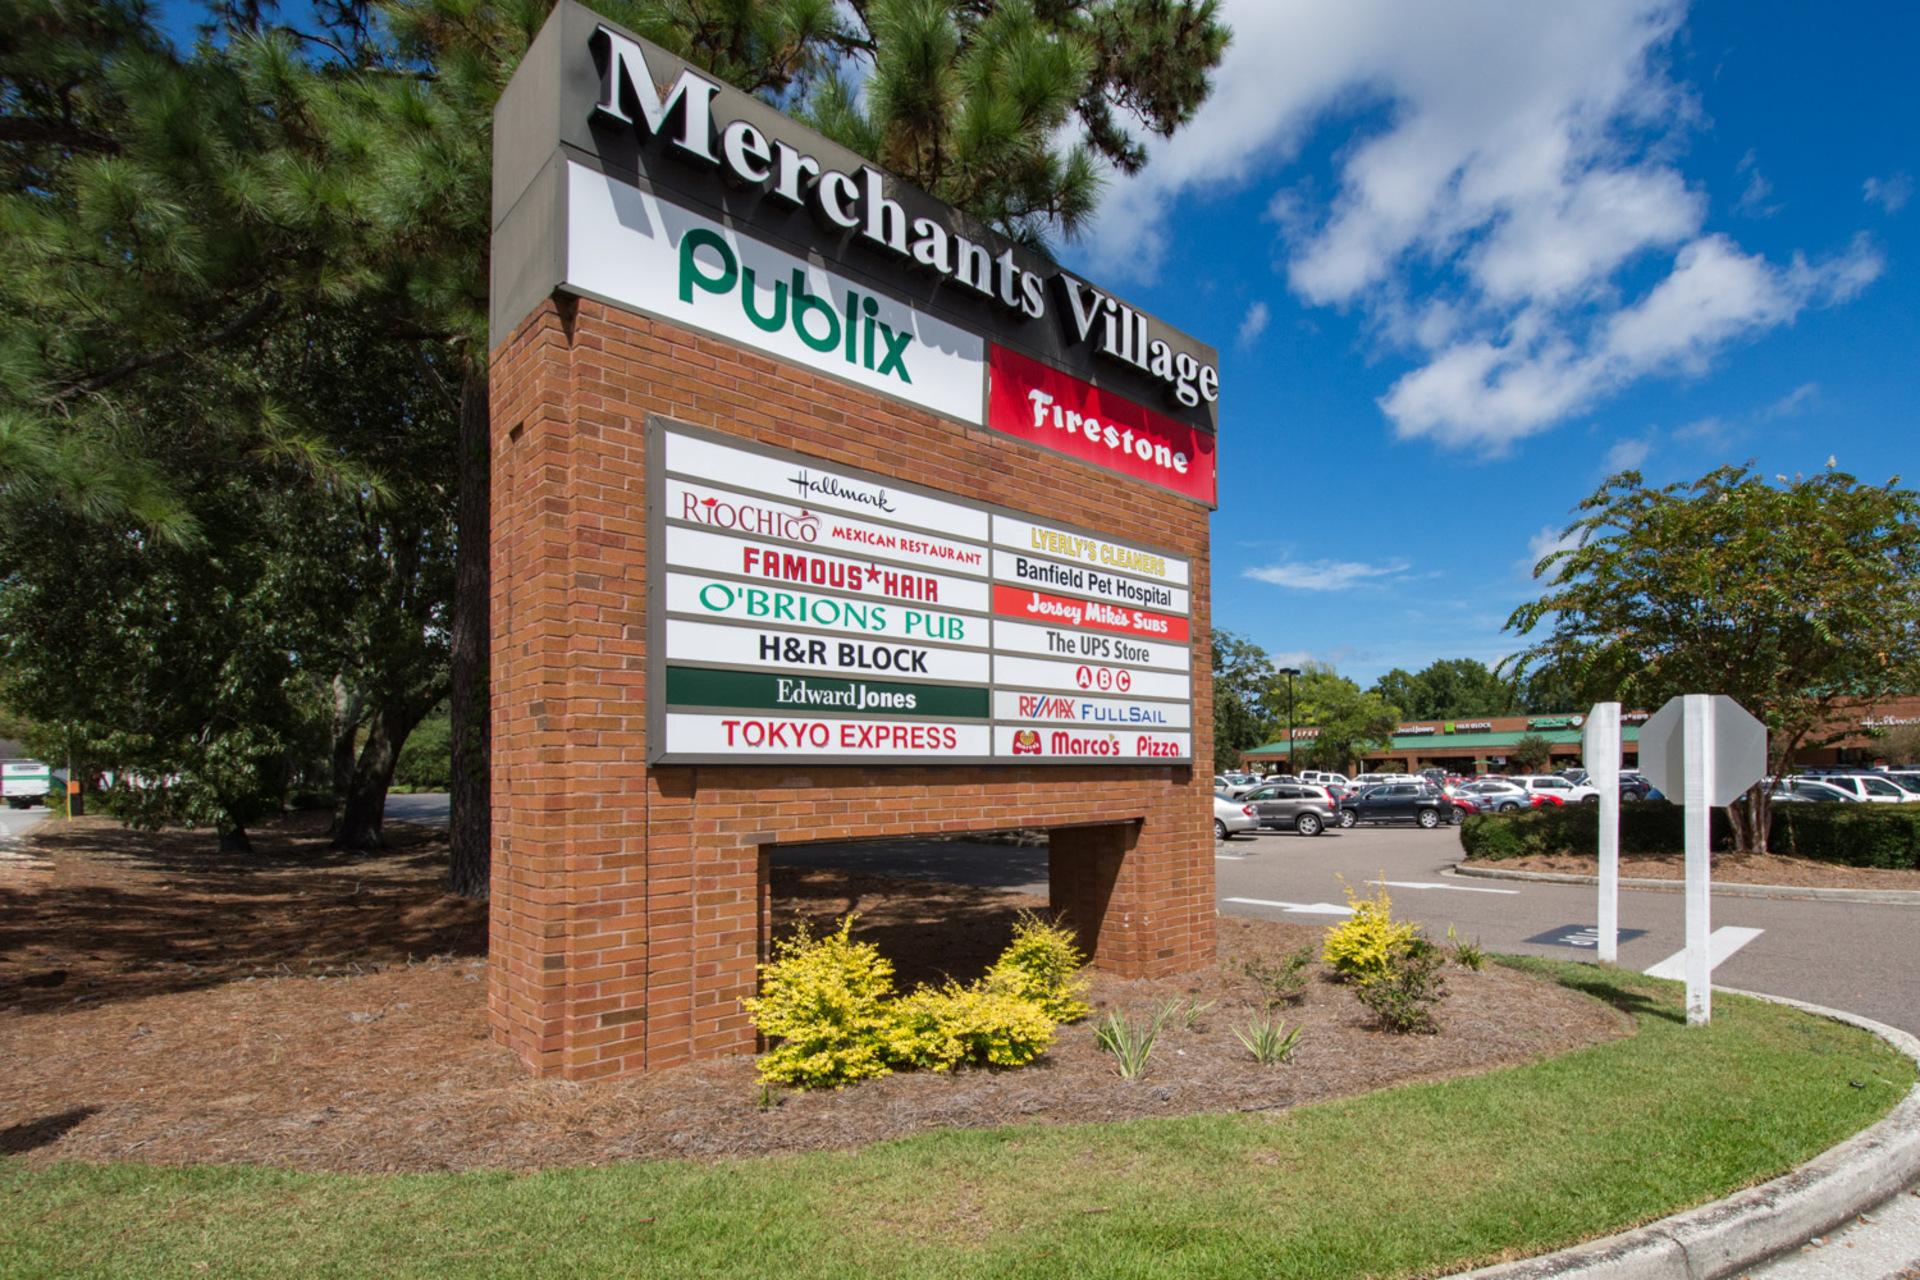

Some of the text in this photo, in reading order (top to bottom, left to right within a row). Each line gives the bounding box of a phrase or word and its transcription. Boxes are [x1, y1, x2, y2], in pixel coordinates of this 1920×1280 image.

[596, 24, 1219, 407] Merchants Village
[679, 229, 913, 385] Publix
[1028, 389, 1188, 474] Firestone
[788, 470, 896, 513] Hallmark
[832, 526, 896, 549] MEXICAN
[900, 539, 981, 566] RESTAURANT
[1031, 527, 1165, 577] LYERLY'S CLEANERS
[1016, 557, 1171, 607] Banfield Pet Hospital
[699, 583, 964, 640] O'BRIONS PUB
[1027, 592, 1081, 625] Jersey
[1085, 602, 1130, 627] Mike's
[759, 635, 928, 673] H&R BLOCK
[1046, 631, 1149, 662] The UPS Store
[1019, 695, 1075, 719] RE/MAX
[722, 720, 957, 750] TOKYO EXPRESS
[1052, 731, 1179, 757] Marco's Pizza
